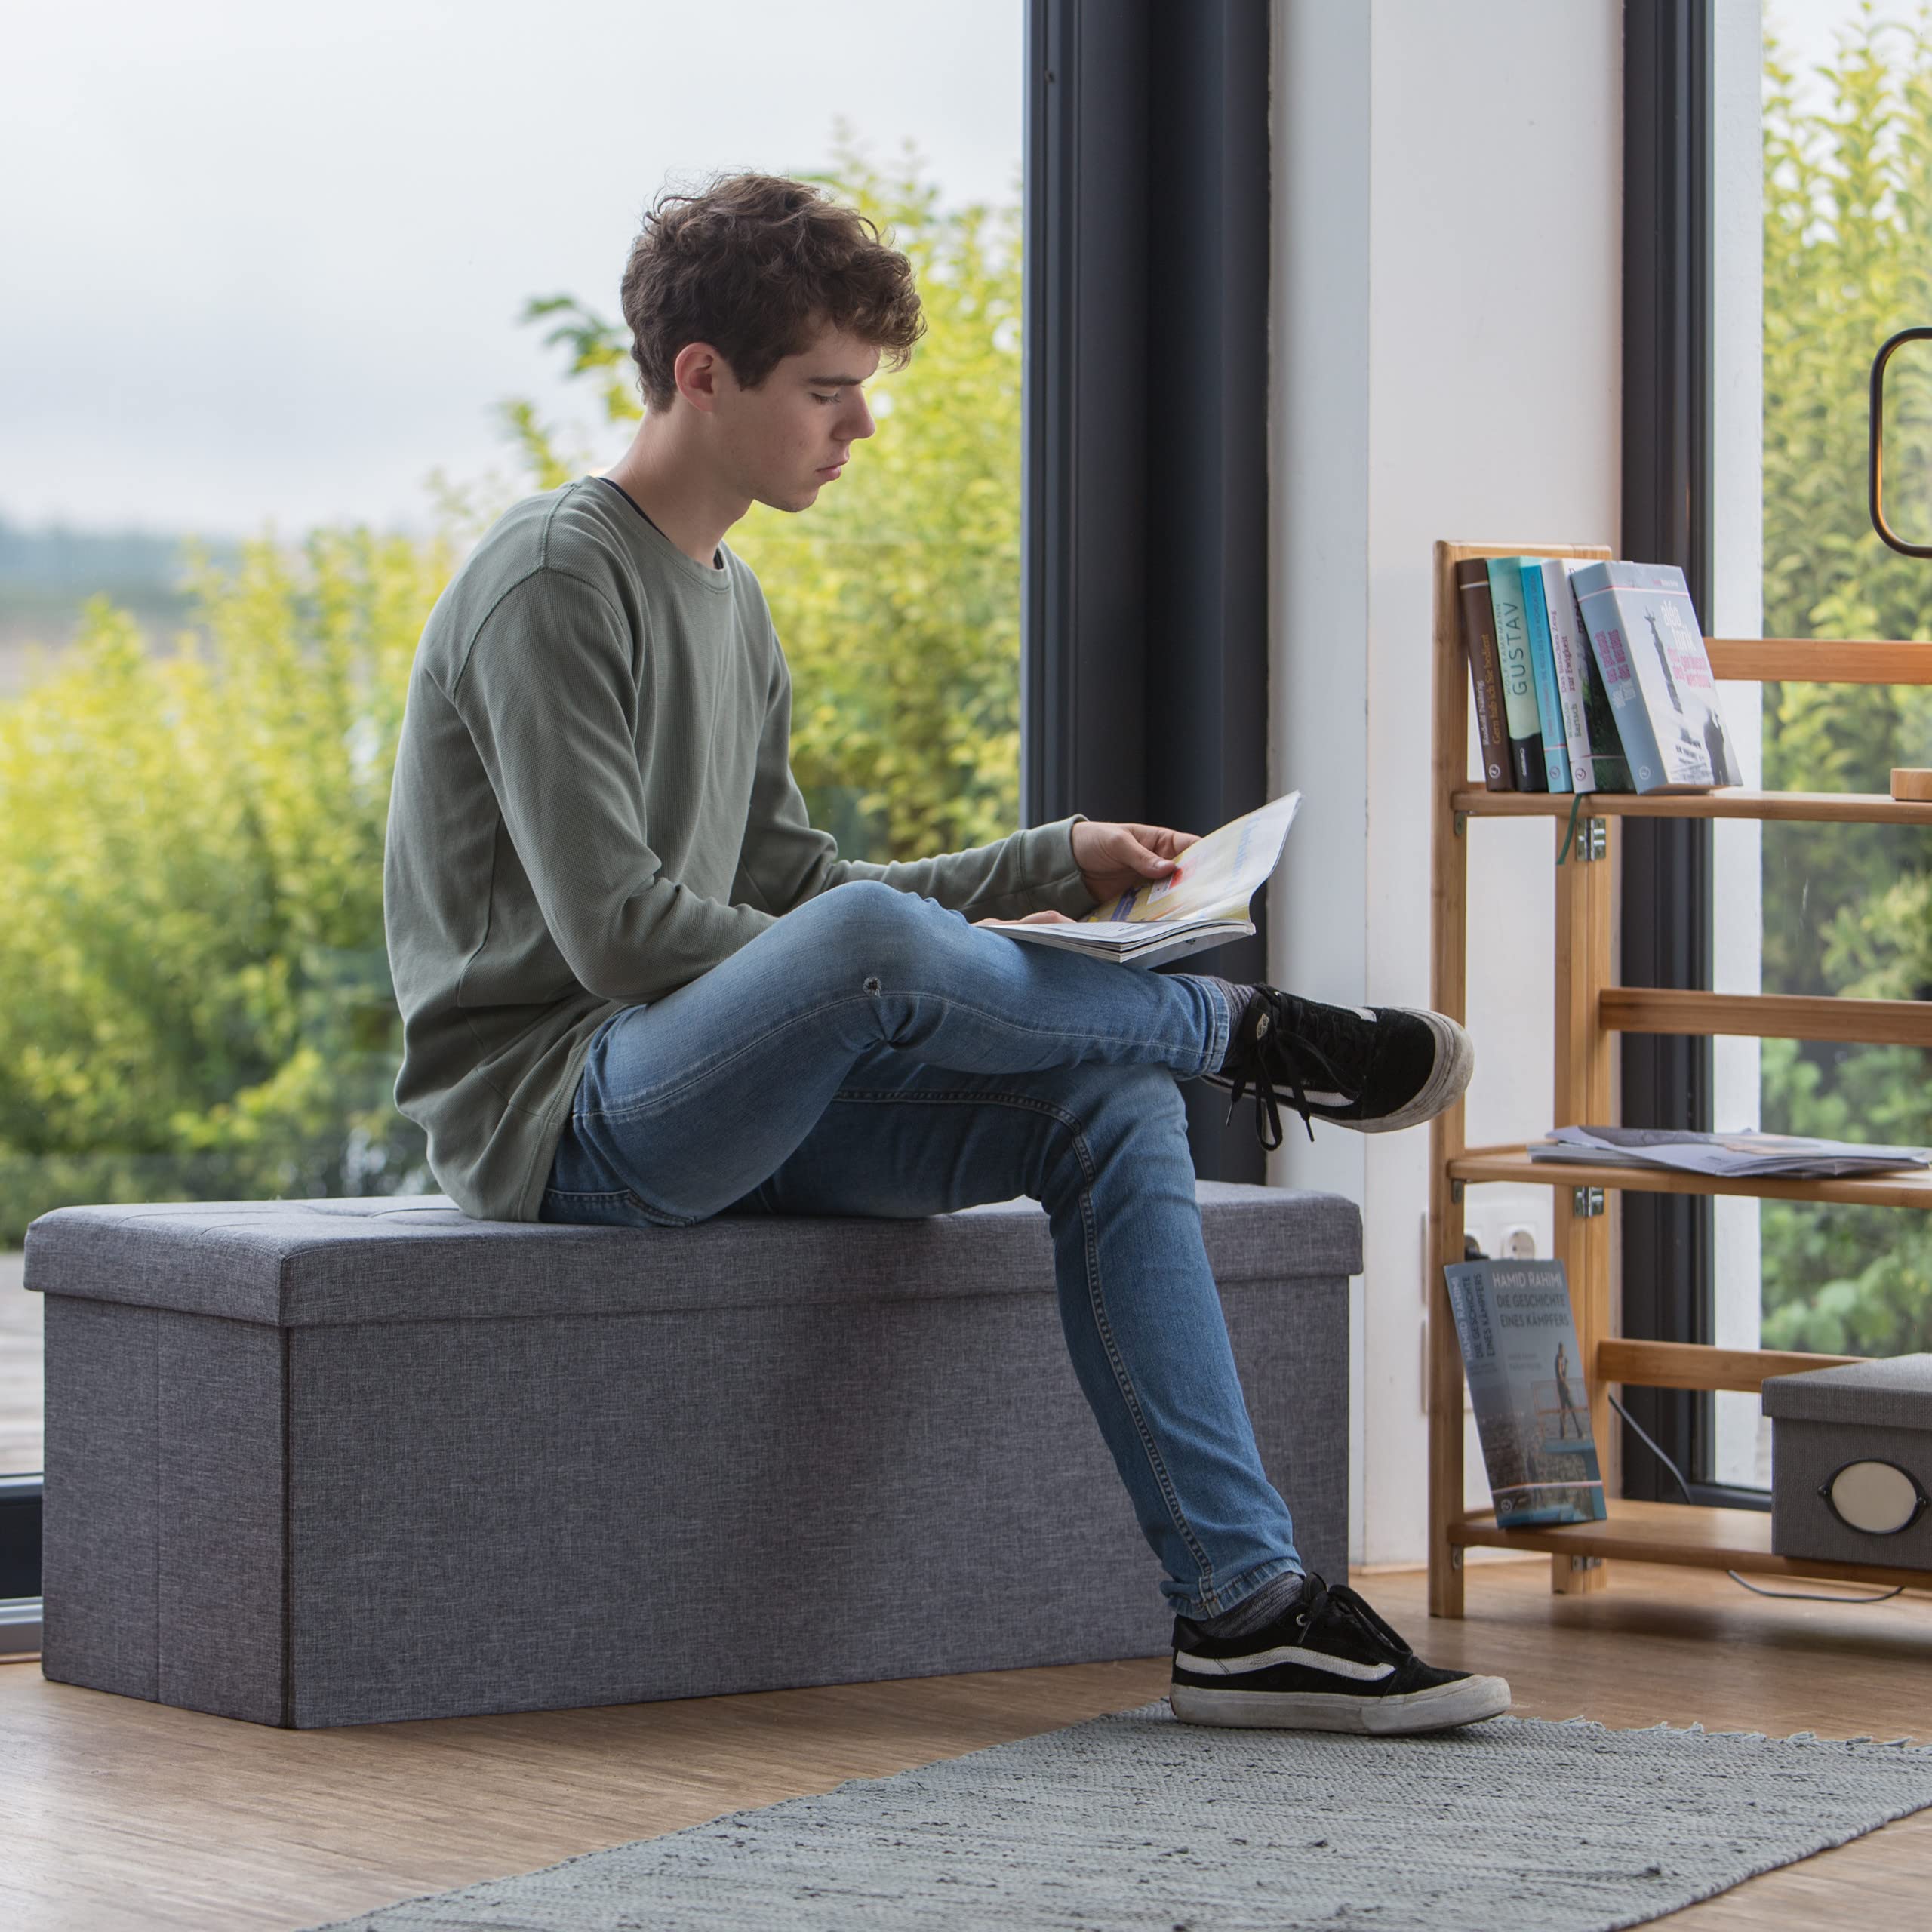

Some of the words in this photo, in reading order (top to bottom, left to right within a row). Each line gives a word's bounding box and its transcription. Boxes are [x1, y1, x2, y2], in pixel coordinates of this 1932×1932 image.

[1503, 602, 1527, 696] GUSTAV
[1561, 636, 1572, 674] Ewigkeit
[1485, 669, 1494, 683] Sie
[1487, 685, 1496, 699] ich
[1488, 700, 1498, 719] hab
[1571, 703, 1581, 737] Bartsch
[1492, 720, 1501, 745] Gern
[1492, 1272, 1526, 1287] HAMID
[1527, 1272, 1562, 1287] RAHIMI
[1451, 1277, 1466, 1318] RAHIMI
[1462, 1275, 1480, 1340] GESCHICHTE
[1497, 1294, 1510, 1308] DIE
[1512, 1294, 1565, 1307] GESCHICHTE
[1500, 1314, 1524, 1328] EINES
[1526, 1312, 1569, 1327] KÄMPFERS
[1459, 1321, 1472, 1360] HAMID
[1474, 1343, 1484, 1358] DIE
[1484, 1328, 1495, 1357] EINES
